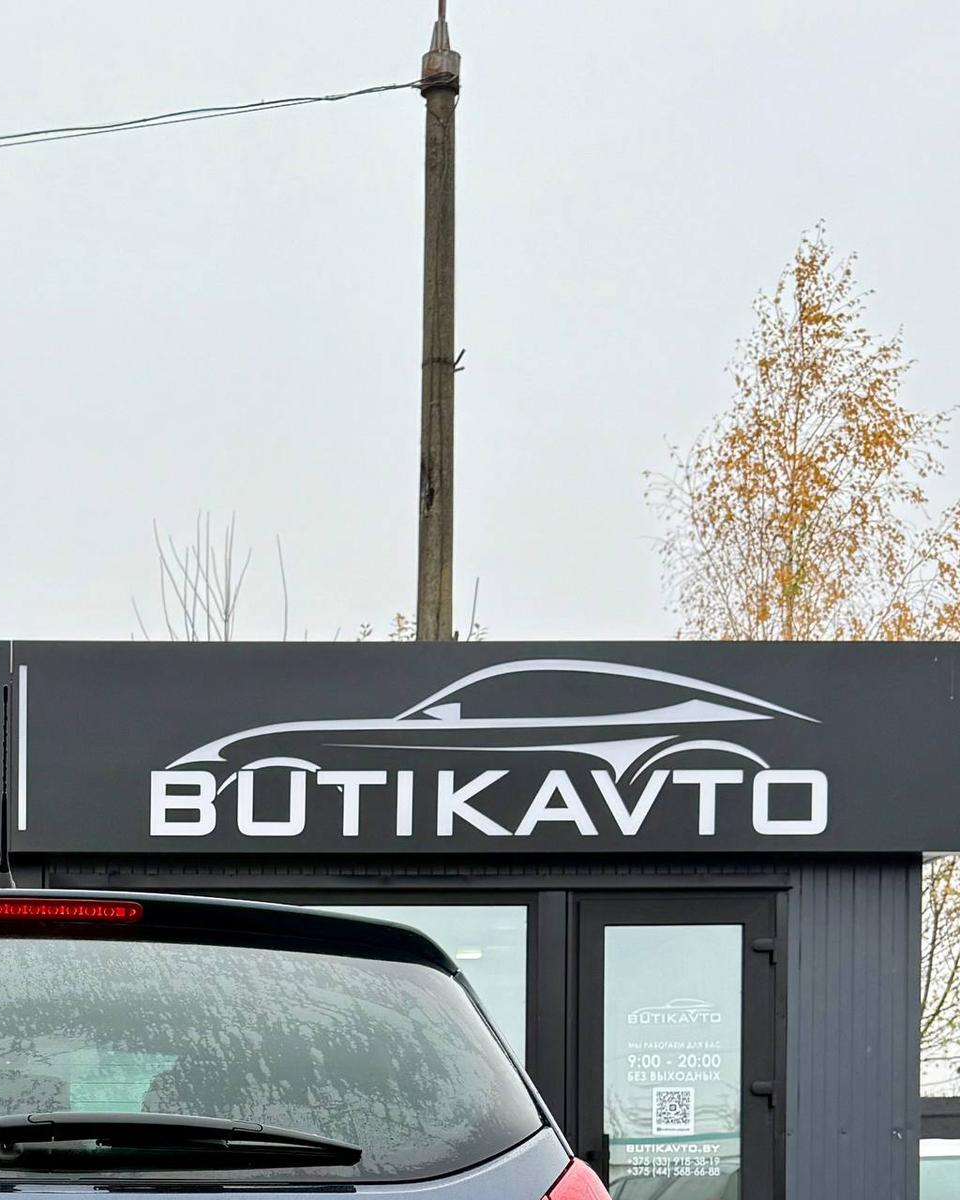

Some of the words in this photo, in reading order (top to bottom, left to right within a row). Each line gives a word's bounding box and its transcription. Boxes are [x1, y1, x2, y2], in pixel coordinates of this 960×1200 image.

[149, 768, 829, 837] BUTIKAVTO
[627, 1012, 721, 1024] BUTIKAVTO
[627, 1054, 661, 1068] 9:00
[678, 1054, 721, 1068] 20:00
[627, 1071, 647, 1081] БЕЗ
[650, 1071, 721, 1082] ВЫХОДНЫХ
[626, 1144, 720, 1153] BUTIKAVTO.BY
[627, 1156, 650, 1166] +375
[652, 1156, 671, 1168] (33)
[627, 1166, 650, 1176] +375
[652, 1167, 671, 1178] (44)
[673, 1166, 720, 1176] 568-66-88
